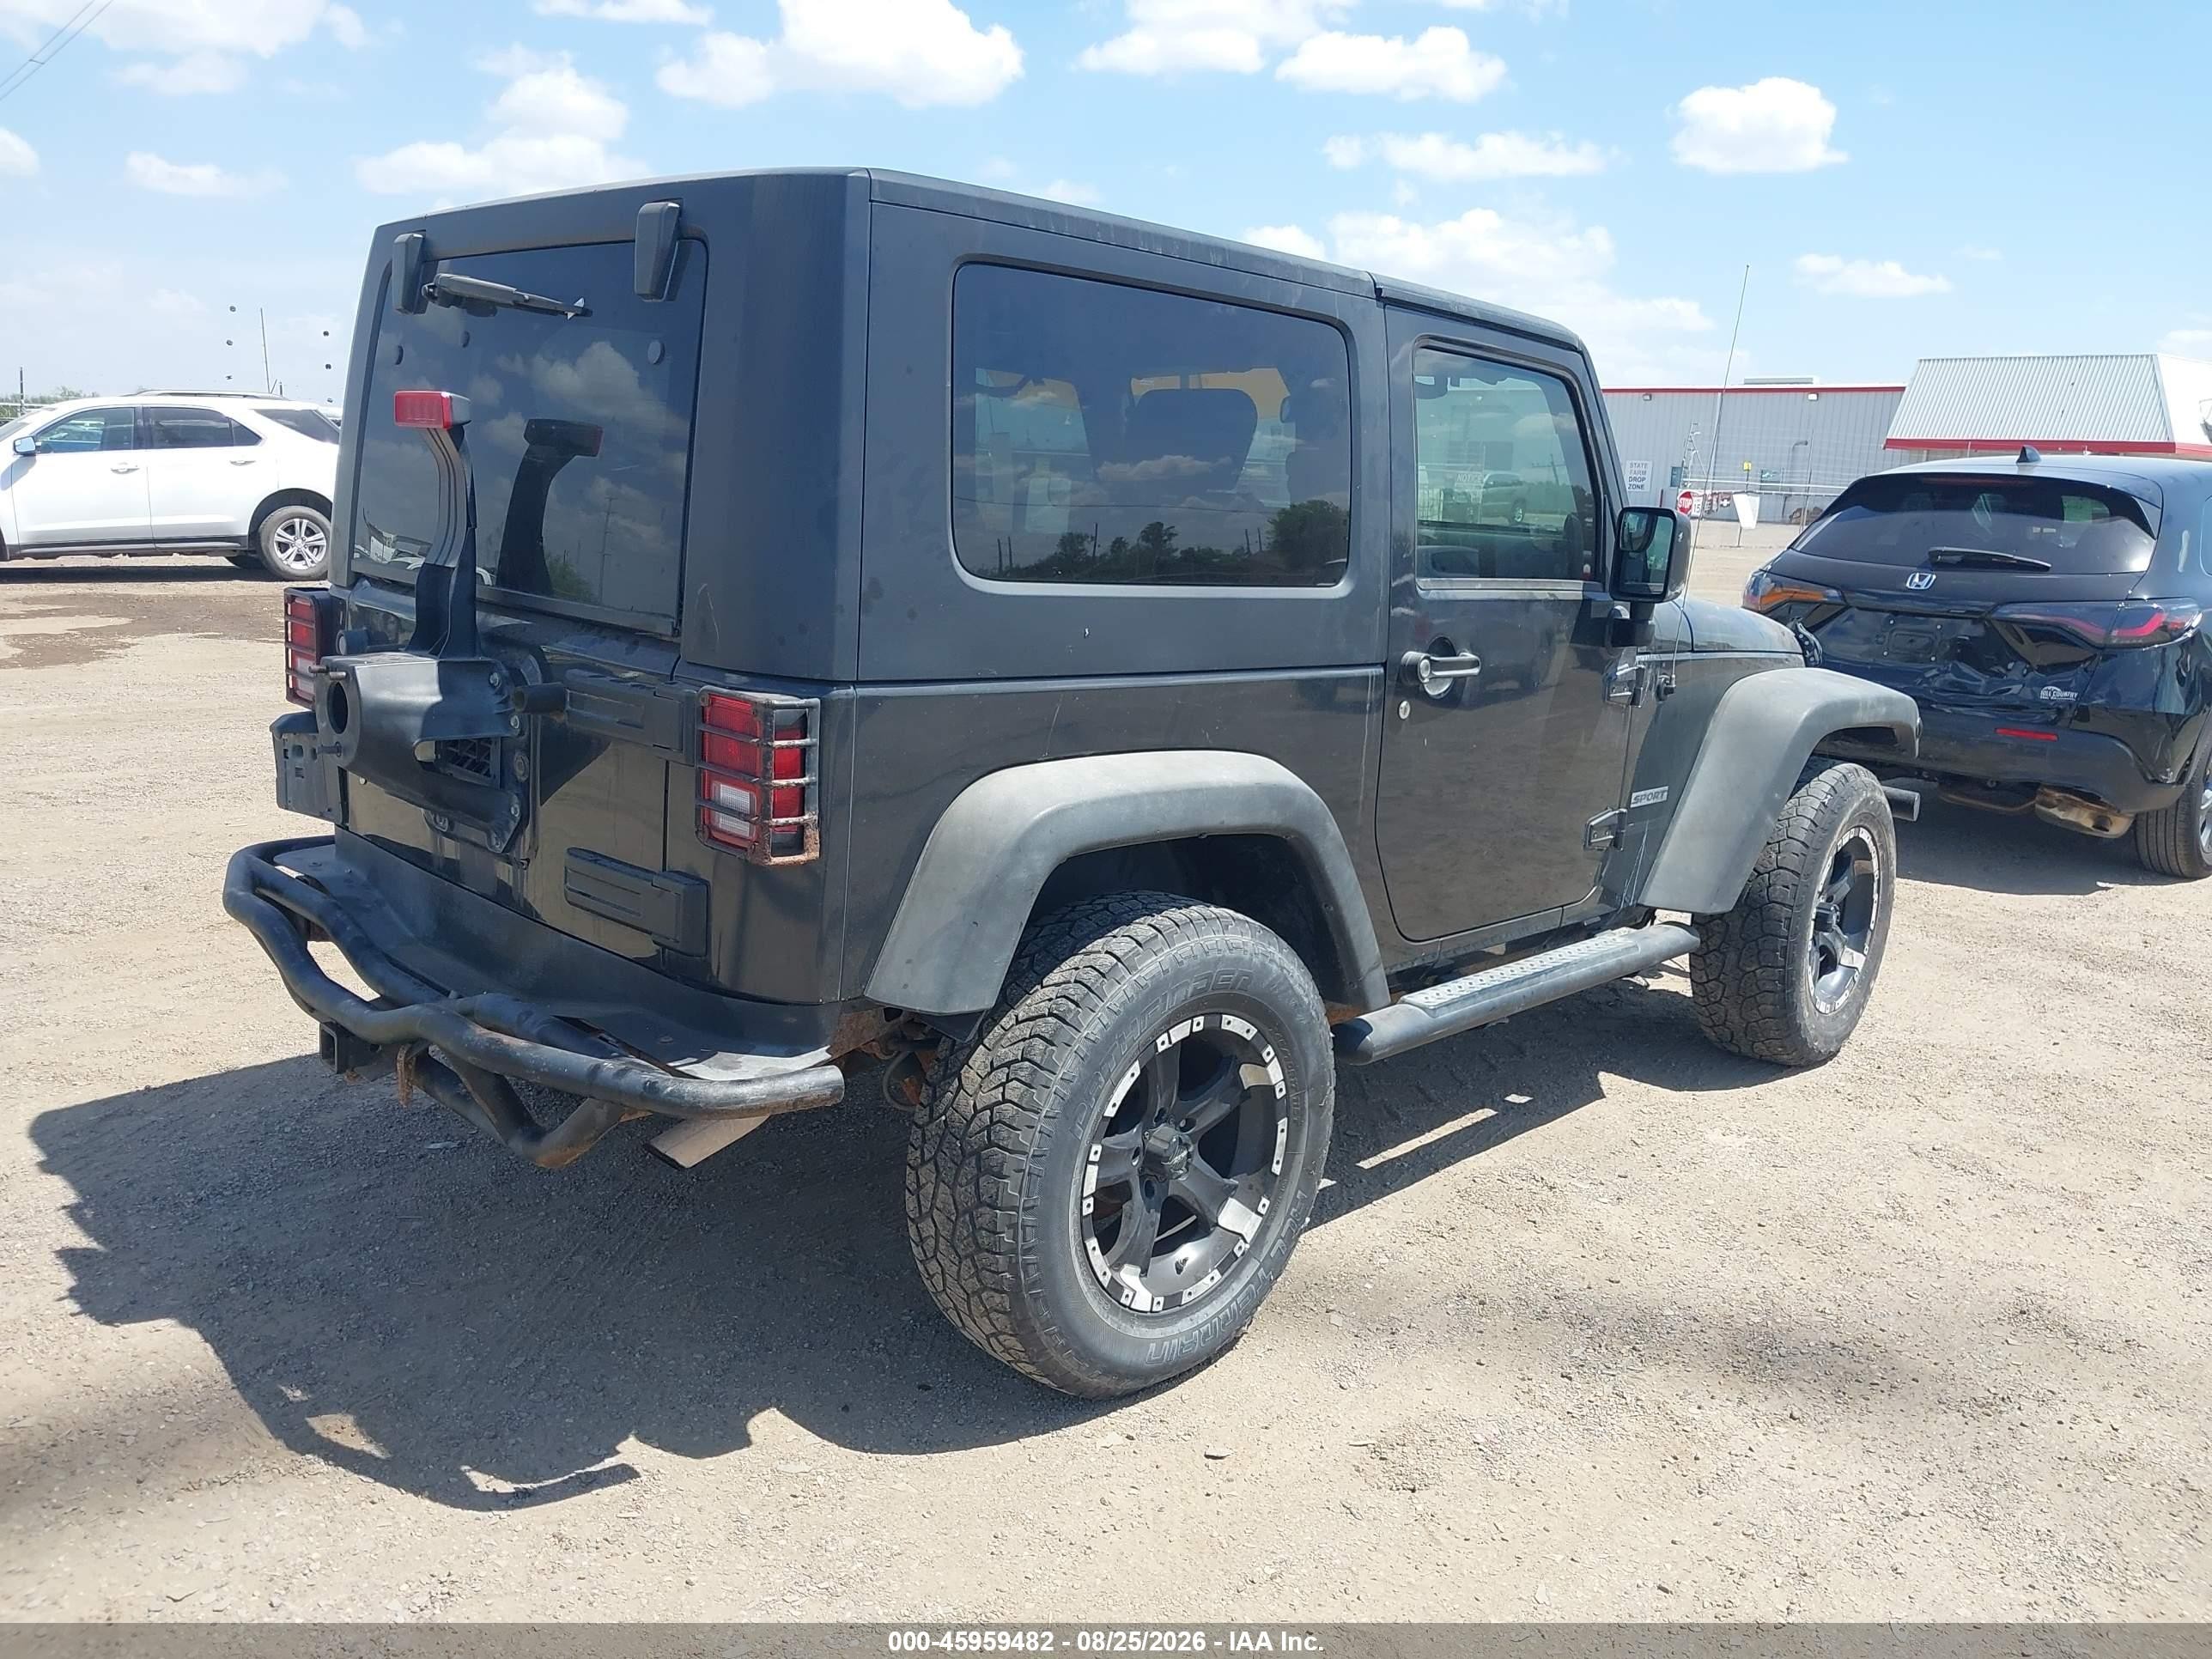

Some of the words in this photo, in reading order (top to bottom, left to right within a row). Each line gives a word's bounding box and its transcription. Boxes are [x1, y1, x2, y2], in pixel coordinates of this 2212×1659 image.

[1678, 497, 1692, 508] STOP
[1633, 791, 1668, 804] SPORT
[1145, 1267, 1273, 1366] TERRAIN
